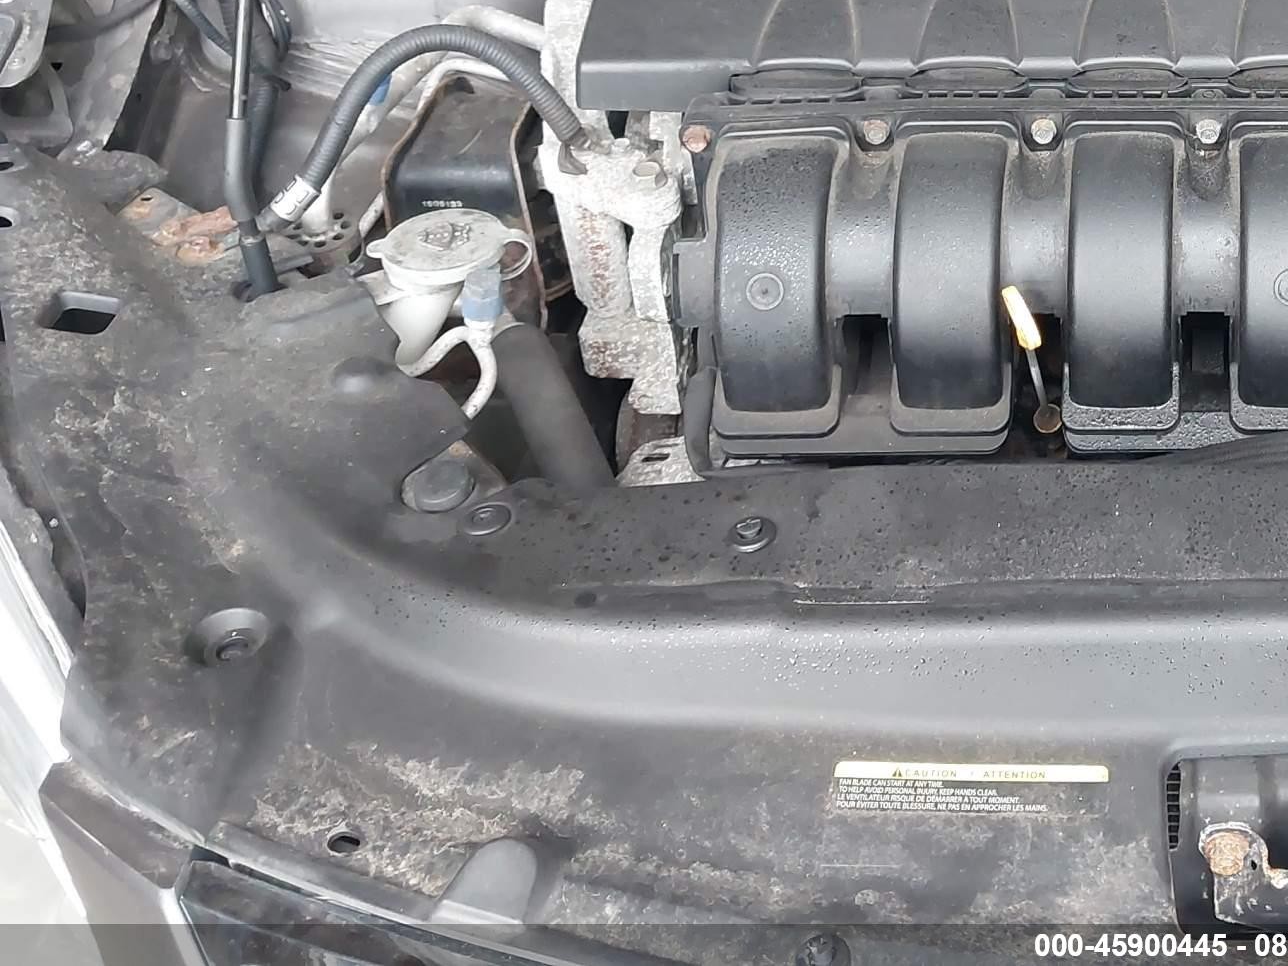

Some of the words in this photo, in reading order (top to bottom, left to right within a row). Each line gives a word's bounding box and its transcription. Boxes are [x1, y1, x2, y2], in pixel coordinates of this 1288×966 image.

[905, 769, 957, 779] CAUTION
[983, 770, 1046, 779] ATTENTION
[839, 778, 852, 786] FAN
[852, 778, 872, 786] BLADE
[887, 779, 905, 787] START
[914, 780, 928, 788] ANY
[848, 786, 864, 794] HELP
[864, 786, 884, 794] AVOID
[884, 787, 916, 795] PERSONAL
[939, 788, 954, 796] KEEP
[954, 788, 977, 796] HANDS
[837, 793, 846, 801] LE
[846, 793, 890, 802] VENTILATEUR
[890, 794, 915, 803] RISQUE
[915, 795, 925, 803] DE
[969, 796, 987, 804] TOUT
[836, 801, 855, 809] POUR
[879, 801, 901, 809] TOUTE
[937, 803, 947, 811] NE
[947, 803, 961, 811] PAS
[961, 804, 971, 812] EN
[971, 803, 1012, 812] APPROCHER
[1012, 804, 1025, 812] LES
